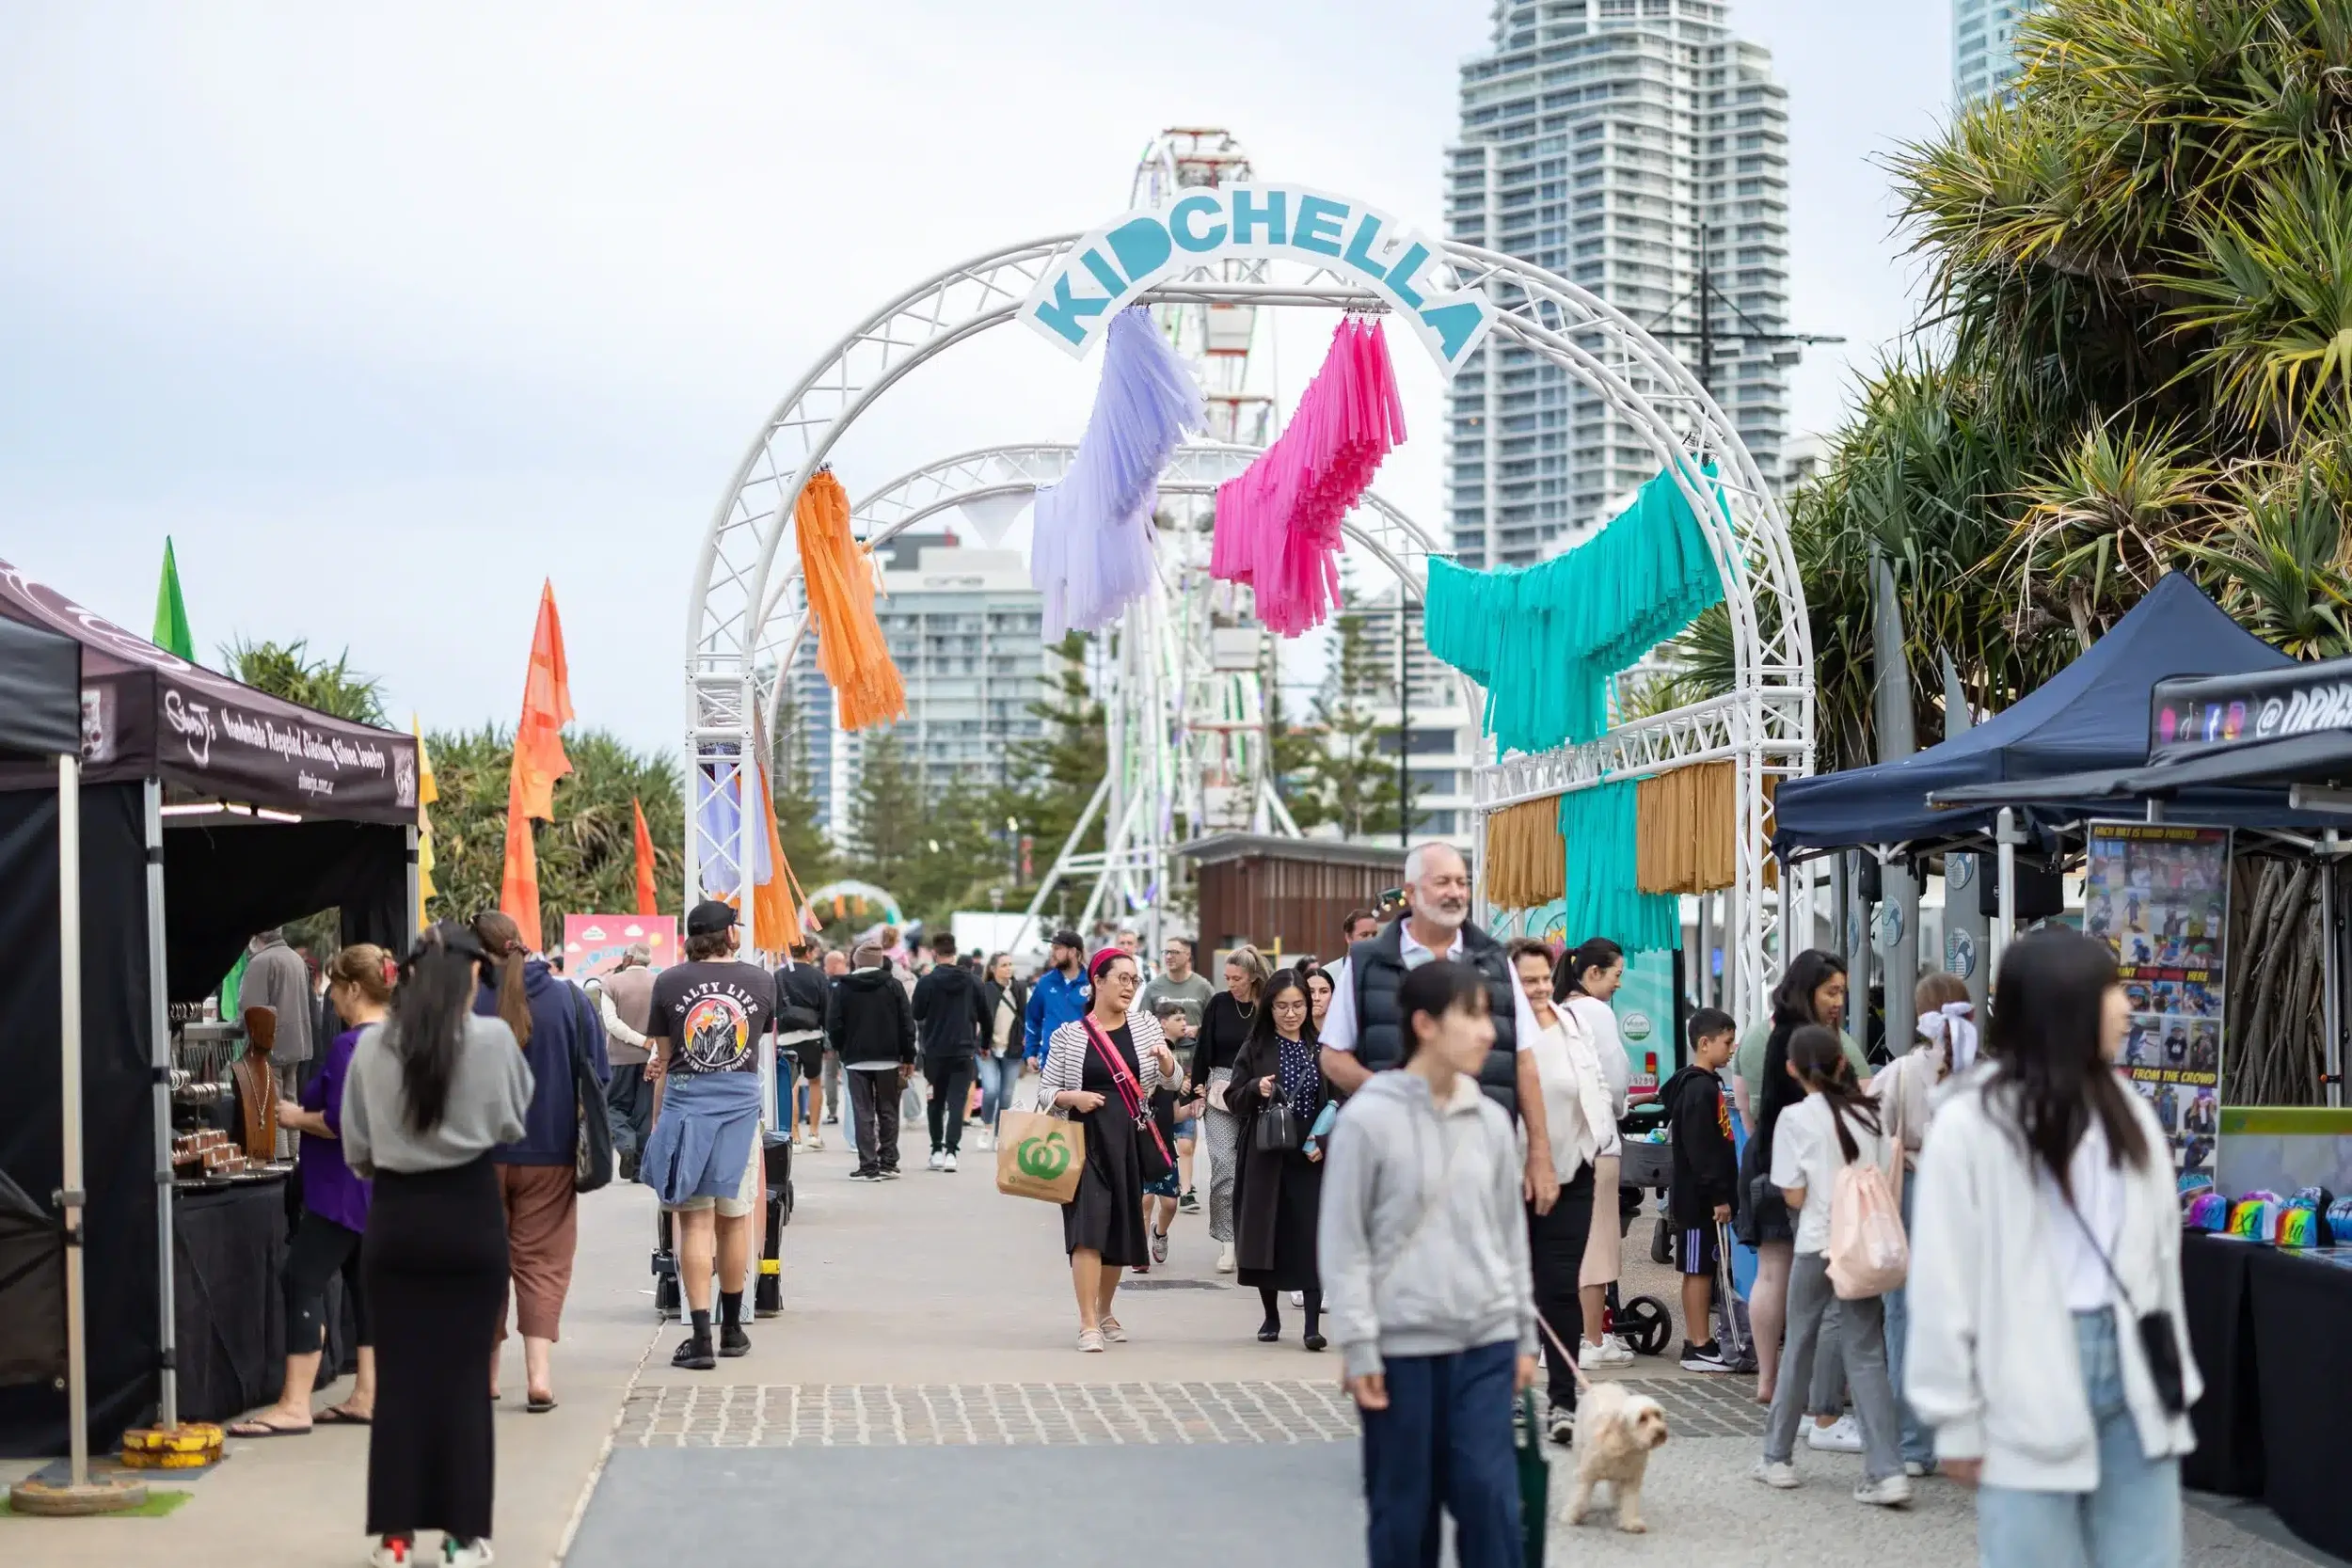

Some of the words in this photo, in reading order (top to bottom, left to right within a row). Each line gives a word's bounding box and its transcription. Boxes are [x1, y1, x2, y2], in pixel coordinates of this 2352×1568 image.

[1034, 190, 1484, 362] KIDCHELLA
[221, 707, 266, 749] Handmade
[265, 721, 302, 762] Recycled
[303, 730, 339, 770] Sterling
[331, 737, 359, 766] Silver
[2186, 971, 2209, 982] HERE
[675, 981, 721, 1013] SALTY
[726, 983, 758, 1015] LIFE
[2132, 1069, 2160, 1081] FROM
[2163, 1070, 2180, 1082] THE
[2181, 1071, 2217, 1084] CROWD
